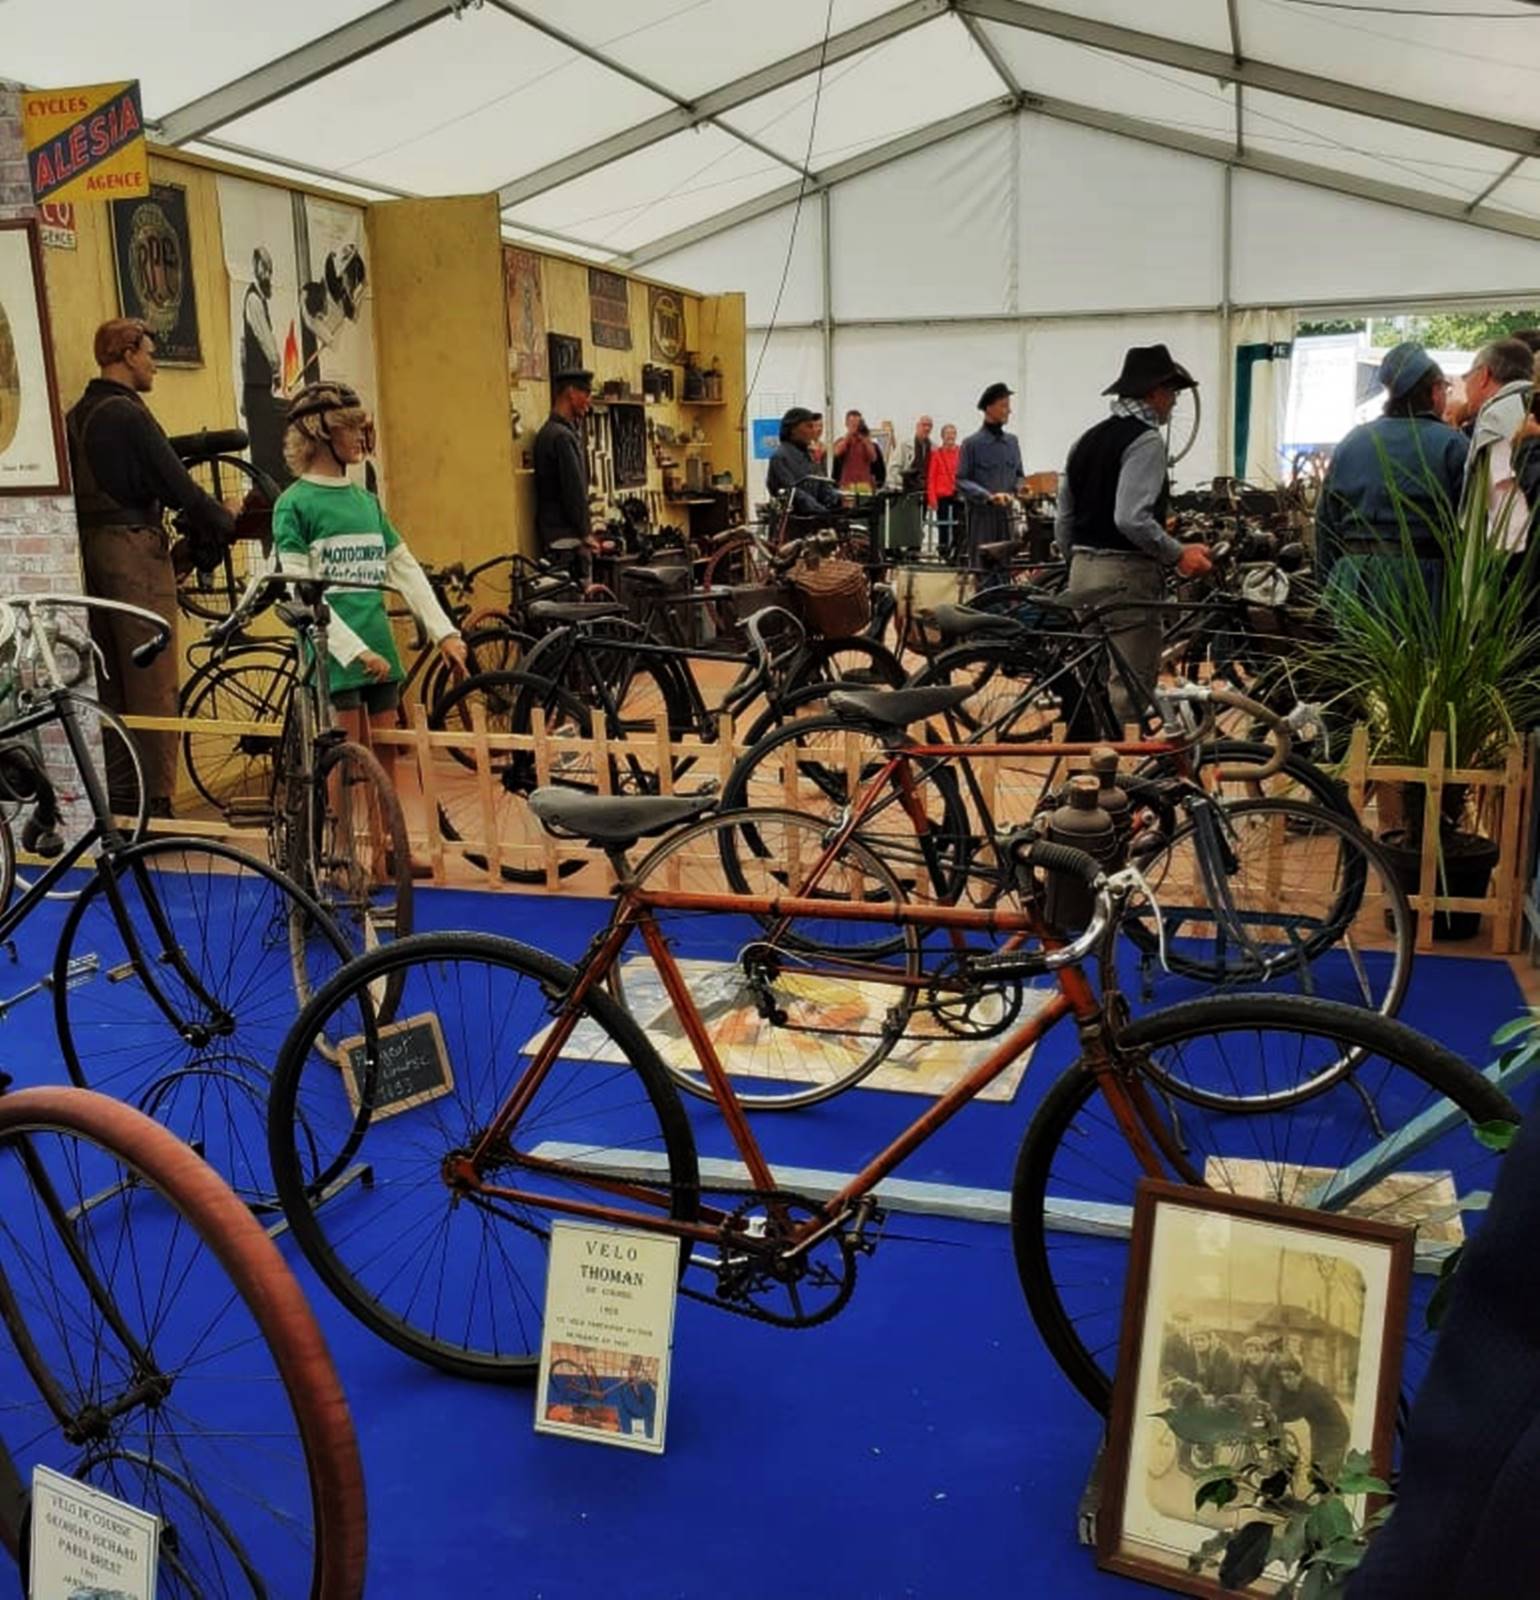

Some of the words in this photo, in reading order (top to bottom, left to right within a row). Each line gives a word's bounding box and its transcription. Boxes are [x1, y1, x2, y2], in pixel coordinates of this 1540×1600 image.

[27, 97, 89, 117] CYCLES
[86, 170, 143, 192] AGENCE
[586, 1240, 638, 1261] VELO
[581, 1265, 643, 1285] THOMAN
